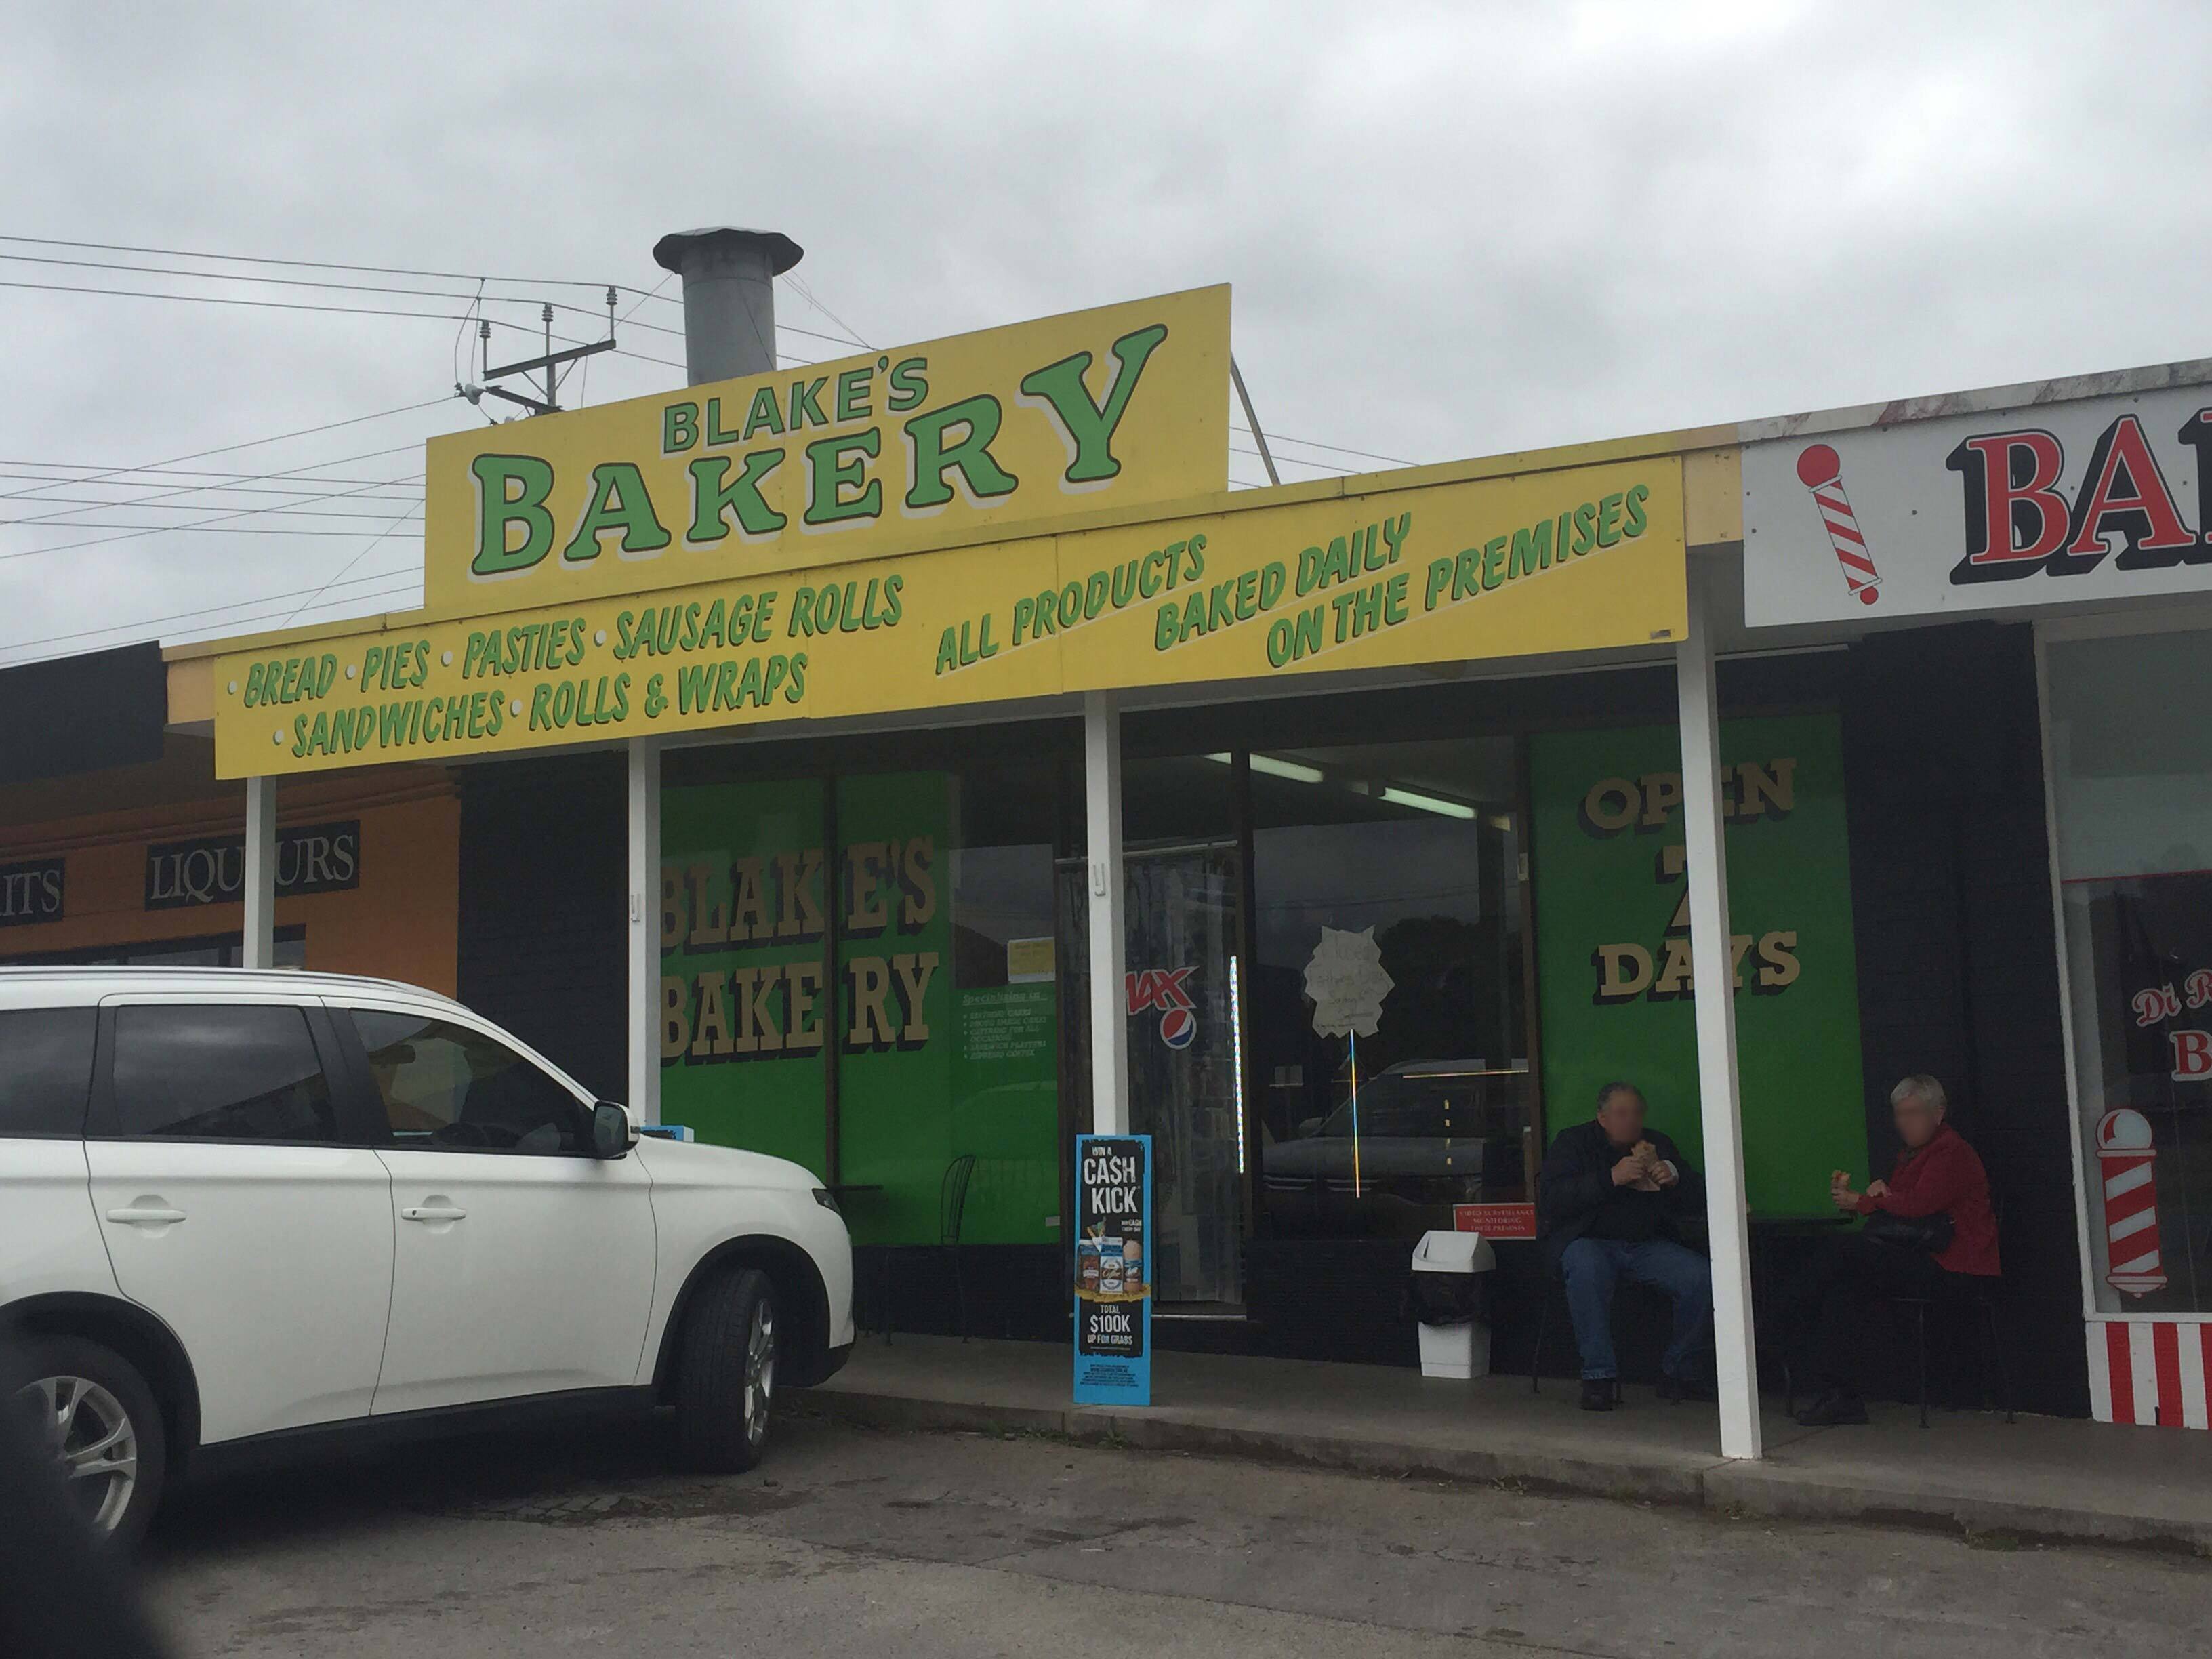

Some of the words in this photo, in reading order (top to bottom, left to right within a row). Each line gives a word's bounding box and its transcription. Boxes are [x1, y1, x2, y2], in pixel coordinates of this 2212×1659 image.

[470, 324, 1168, 577] BAKERY
[661, 356, 929, 454] BLAKE'S
[1949, 407, 2212, 581] BA
[935, 612, 999, 674] ALL
[1012, 534, 1208, 647] PRODUCTS
[1154, 561, 1285, 651] BAKED
[1295, 512, 1412, 596] DAILY
[1267, 609, 1324, 668] ON
[1332, 572, 1409, 642] THE
[1424, 483, 1650, 611] PREMISES
[244, 653, 337, 708] BREAD
[361, 639, 430, 693] PIES
[462, 617, 586, 679] PASTIES
[613, 591, 778, 659] SAUSAGE
[788, 574, 903, 638] ROLLS
[292, 690, 504, 758] SANDWICHES
[528, 674, 630, 731] ROLLS
[644, 674, 669, 717] &
[678, 652, 808, 714] WRAPS
[0, 869, 61, 916] ITS
[150, 834, 354, 903] LIQUURS
[1092, 1185, 1138, 1214] KICK
[1087, 1334, 1097, 1343] UP
[1097, 1334, 1110, 1343] FOR
[1090, 1314, 1131, 1334] $100K
[1100, 1304, 1120, 1314] TOTAL
